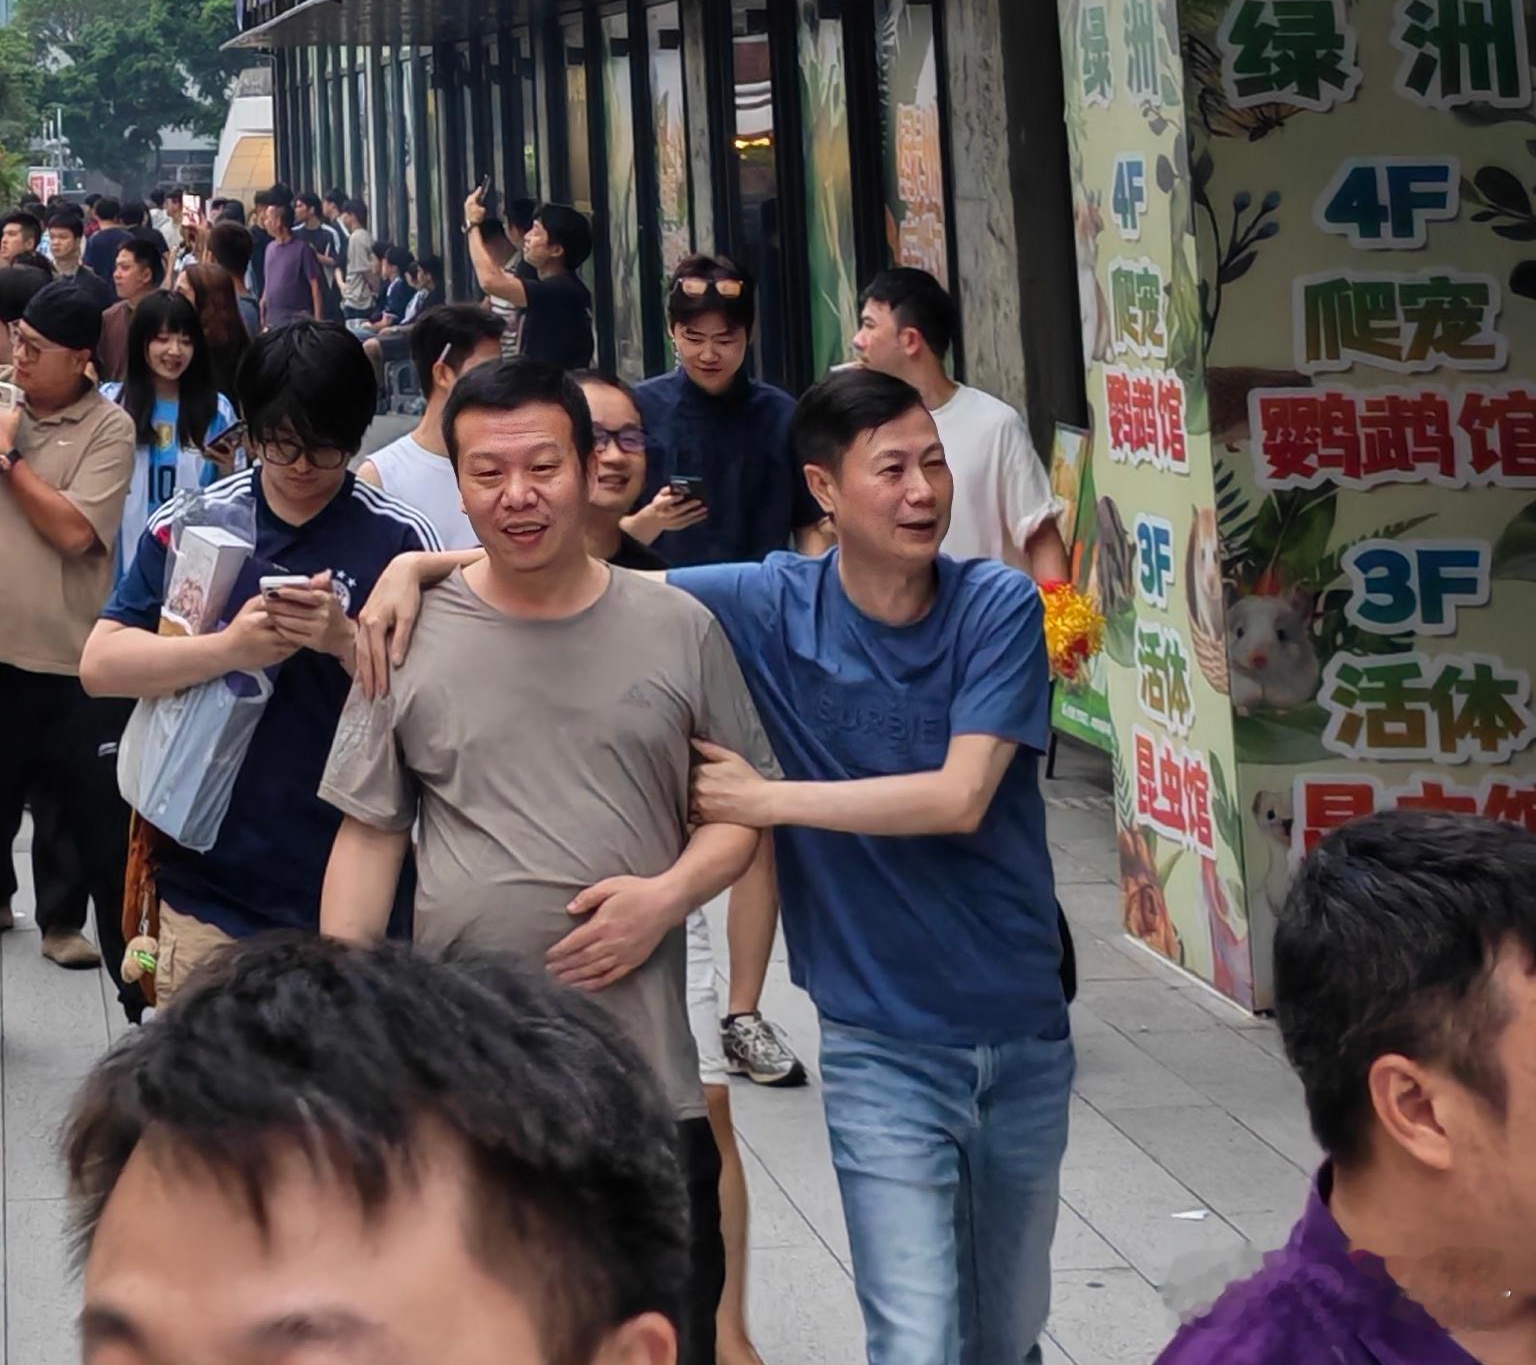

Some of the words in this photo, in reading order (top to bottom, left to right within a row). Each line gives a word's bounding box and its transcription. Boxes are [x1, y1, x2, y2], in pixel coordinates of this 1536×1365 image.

[1112, 160, 1145, 231] 4F
[1324, 164, 1450, 239] 4F
[1304, 274, 1497, 364] 爬宠
[1106, 372, 1187, 464] 鹦鹉馆
[1257, 389, 1536, 479] 鹦鹉馆
[1138, 520, 1171, 598] 3F
[1352, 548, 1481, 625] 3F
[1137, 629, 1191, 724] 活体
[1335, 662, 1527, 757] 活体
[1134, 733, 1214, 850] 昆虫馆
